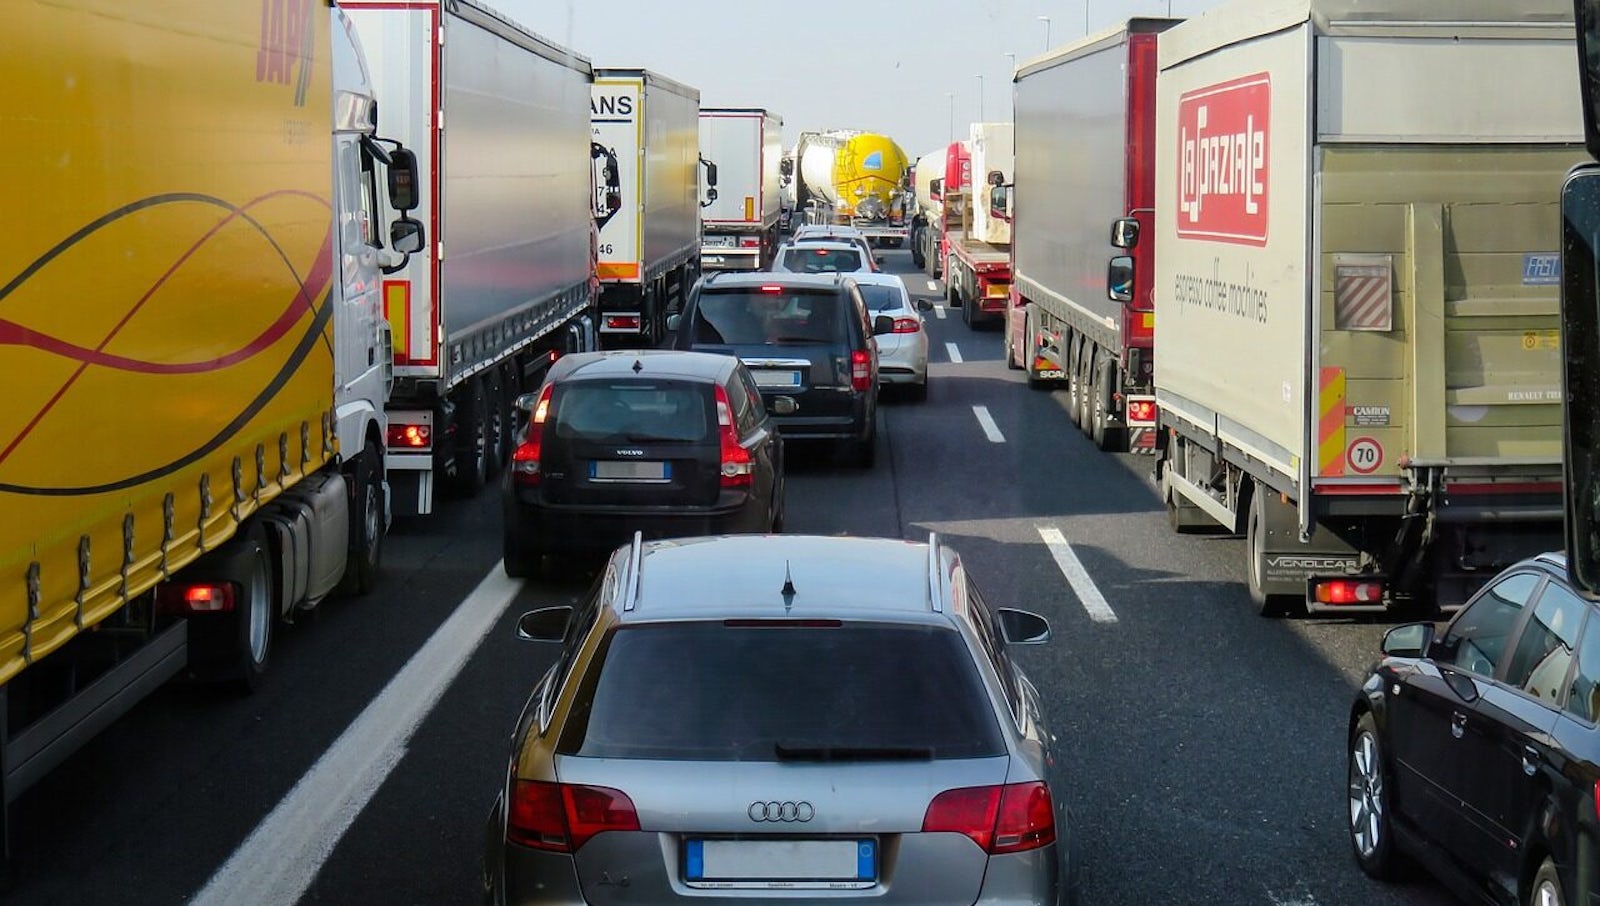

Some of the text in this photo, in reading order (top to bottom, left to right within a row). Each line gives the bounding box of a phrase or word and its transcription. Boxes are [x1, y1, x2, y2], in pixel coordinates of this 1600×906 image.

[1527, 256, 1559, 276] FAST
[1175, 256, 1267, 324] espresso coffee machines
[1357, 448, 1374, 463] 70
